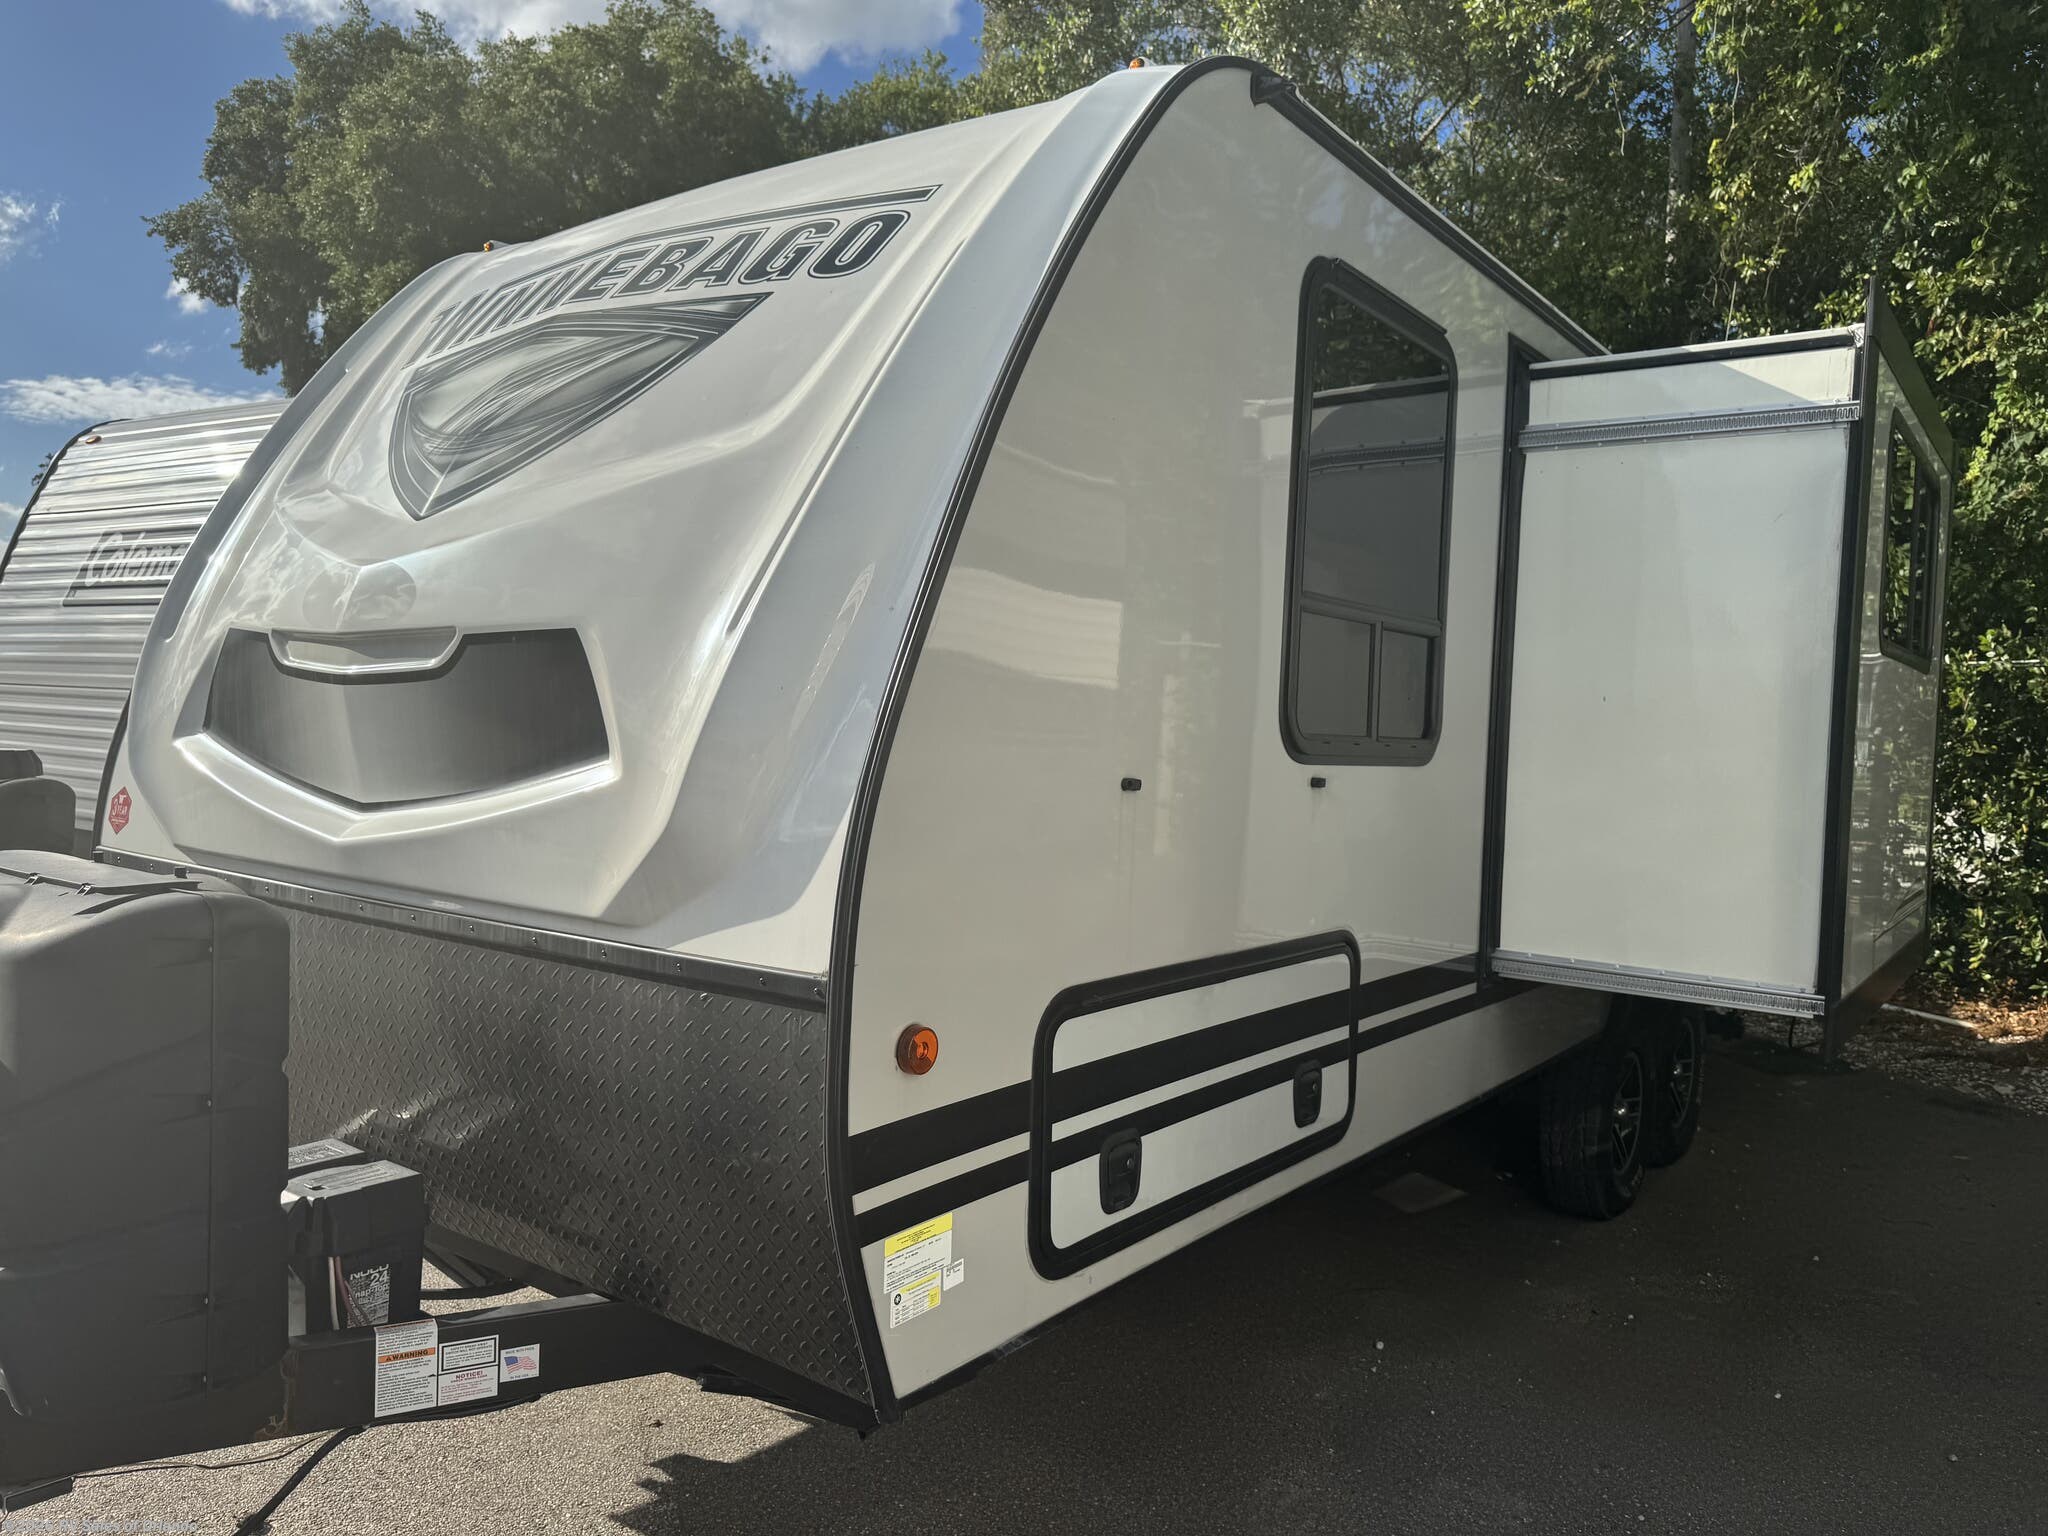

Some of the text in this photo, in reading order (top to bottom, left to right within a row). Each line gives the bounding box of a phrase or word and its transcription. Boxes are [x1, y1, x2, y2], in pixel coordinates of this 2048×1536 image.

[402, 210, 911, 369] WINNEBAGO
[370, 1270, 390, 1286] 24
[392, 1349, 428, 1360] WARNING
[455, 1371, 483, 1379] NOTICE!
